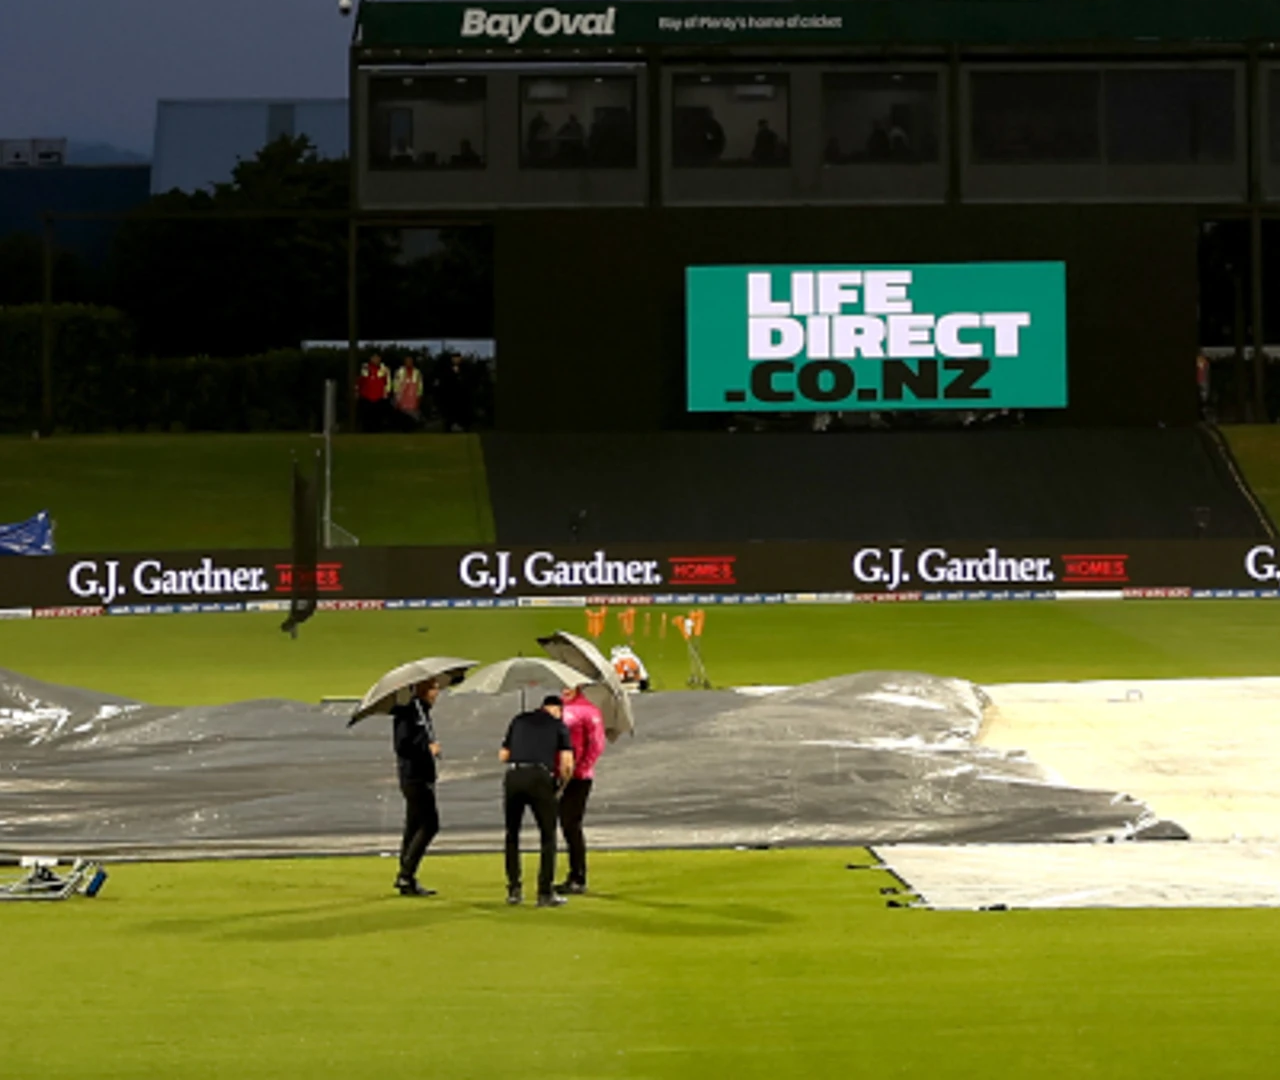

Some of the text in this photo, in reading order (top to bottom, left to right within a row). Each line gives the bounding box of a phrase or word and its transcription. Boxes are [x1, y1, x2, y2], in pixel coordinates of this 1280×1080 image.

[461, 7, 616, 43] Bay Oval
[748, 15, 785, 28] home
[748, 270, 912, 316] LIFE
[748, 312, 1031, 359] DIRECT
[725, 359, 991, 402] .CO.NZ
[69, 560, 126, 600] G.J.
[133, 557, 268, 596] Gardner.
[460, 550, 732, 593] G.J. Gardner. HOMES
[853, 548, 1124, 589] G.J. Gardner. HOMES
